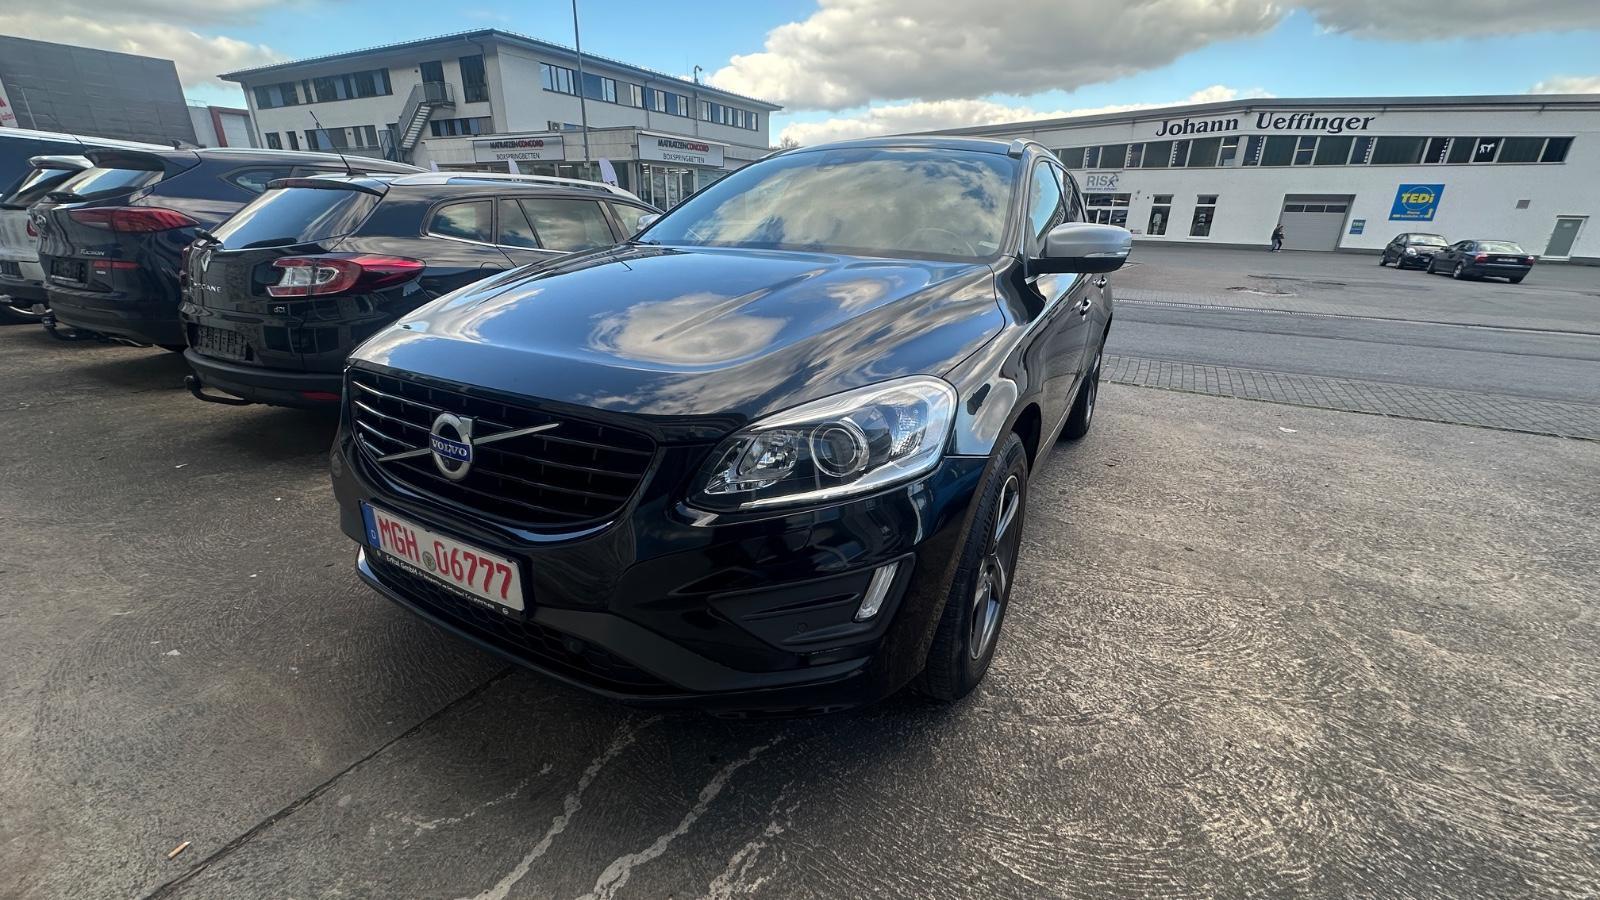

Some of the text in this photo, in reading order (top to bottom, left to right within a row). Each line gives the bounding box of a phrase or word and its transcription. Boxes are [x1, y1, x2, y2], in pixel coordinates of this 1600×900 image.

[1156, 112, 1375, 137] Johann Ueffinger
[663, 153, 705, 163] BOXSPRINGBETTEN
[431, 439, 467, 456] VOLVO
[378, 515, 420, 562] MGH
[433, 540, 513, 600] 06777
